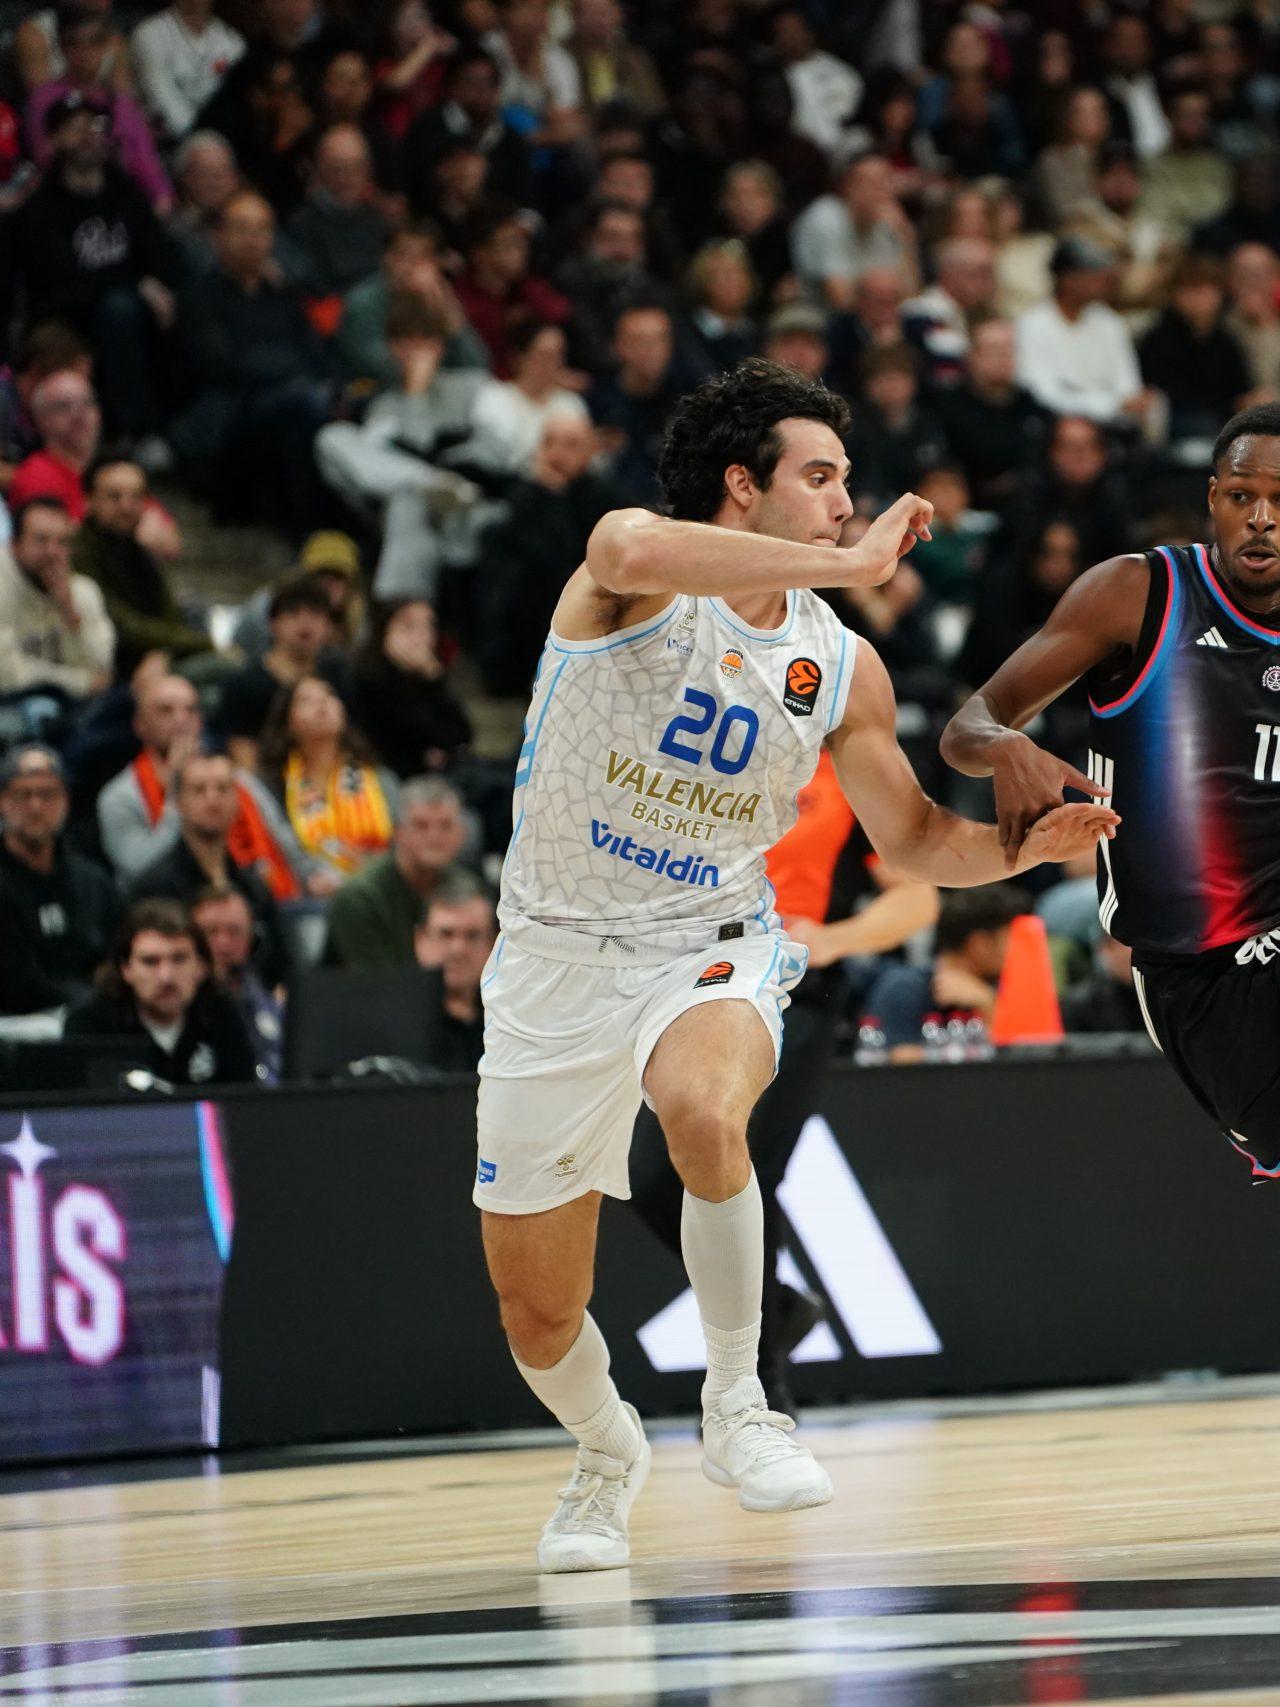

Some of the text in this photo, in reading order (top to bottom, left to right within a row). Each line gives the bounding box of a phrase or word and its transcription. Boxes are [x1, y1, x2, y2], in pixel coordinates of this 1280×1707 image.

[658, 687, 760, 776] 20
[603, 749, 762, 823] VALENCIA
[630, 801, 717, 841] BASKET
[0, 1170, 127, 1367] IS
